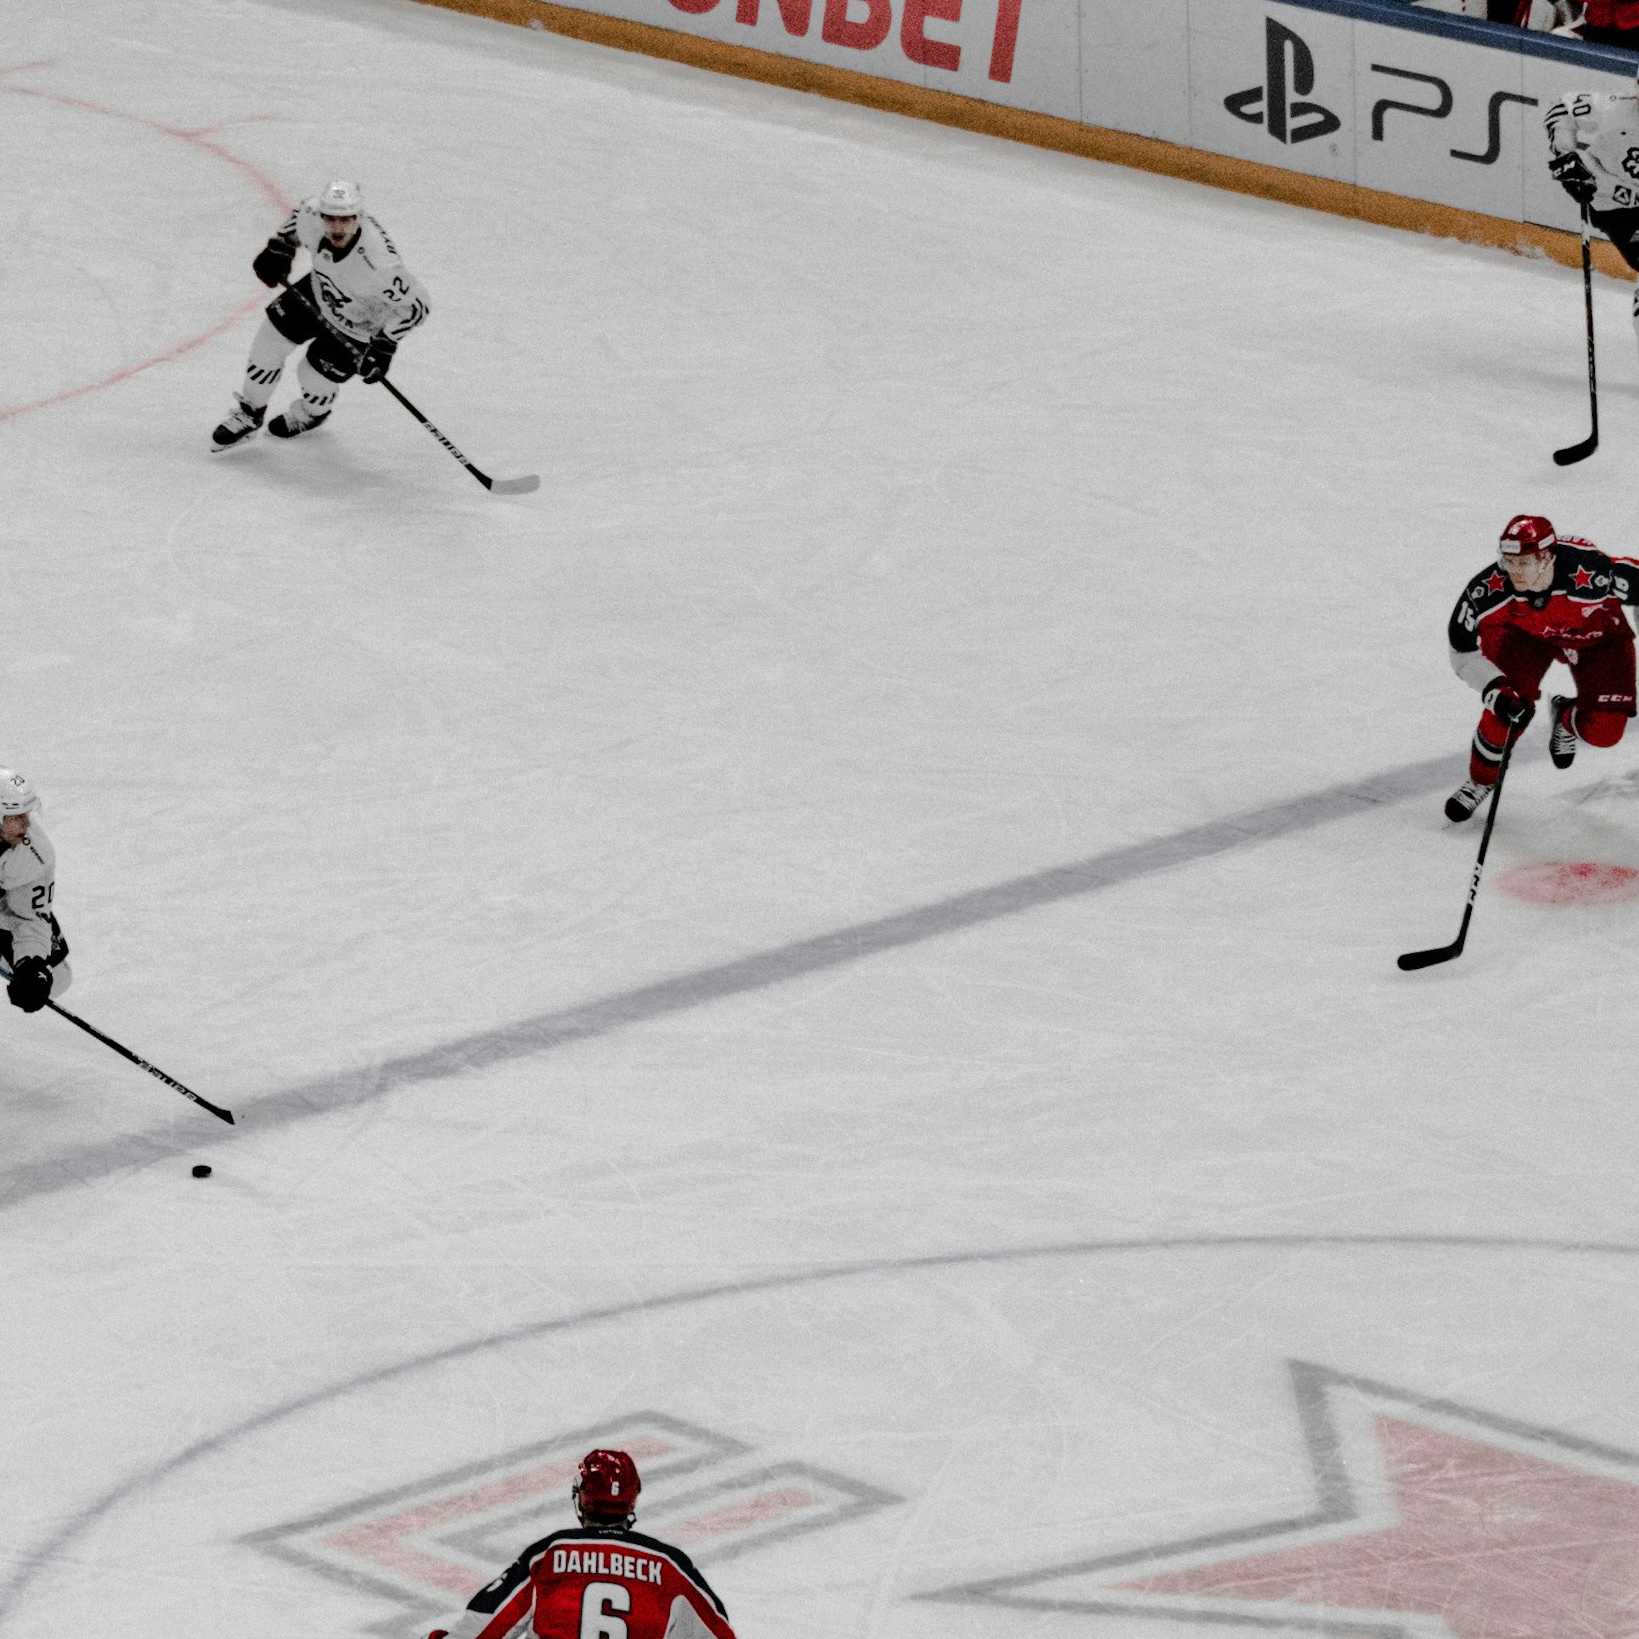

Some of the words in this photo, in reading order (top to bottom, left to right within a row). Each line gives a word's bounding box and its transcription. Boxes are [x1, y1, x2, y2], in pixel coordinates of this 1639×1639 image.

[382, 276, 410, 303] 22
[610, 1480, 619, 1496] 6
[552, 1549, 663, 1586] DAHLBECK
